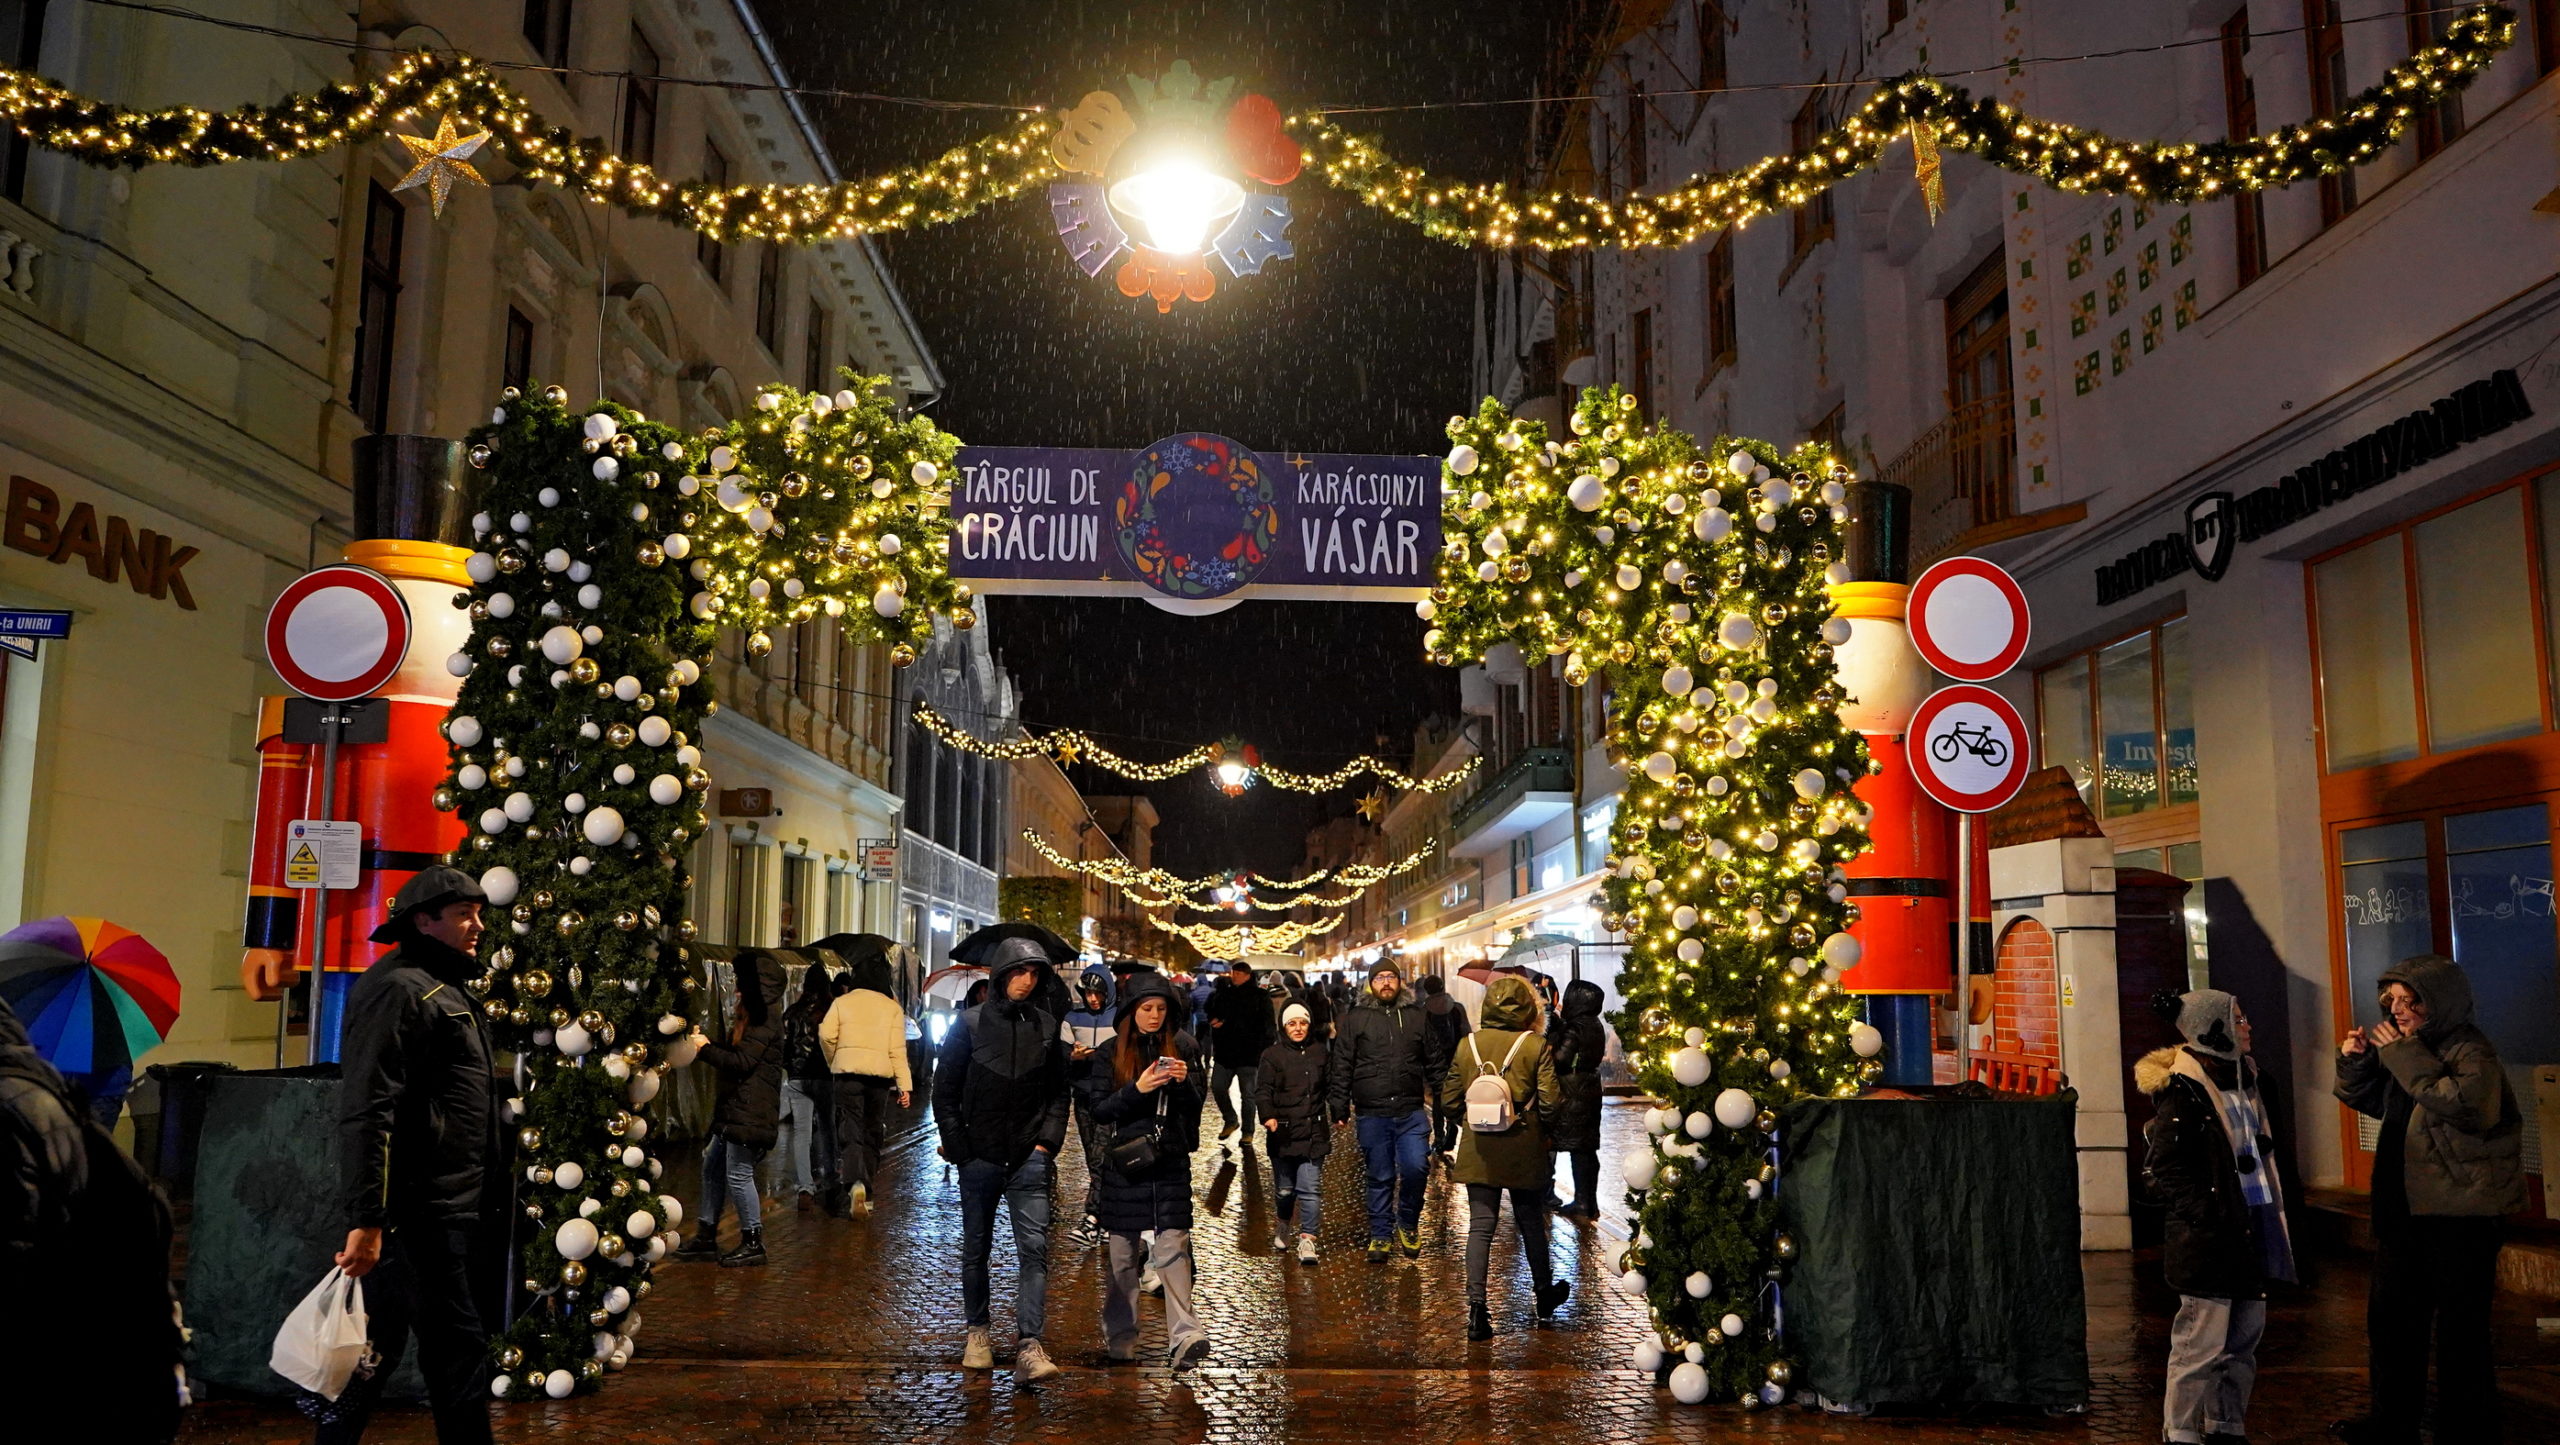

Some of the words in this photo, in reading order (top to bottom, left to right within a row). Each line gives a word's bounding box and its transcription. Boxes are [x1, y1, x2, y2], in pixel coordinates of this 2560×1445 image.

[962, 459, 1057, 505] TÂRGUL
[1069, 468, 1101, 506] DE
[1298, 466, 1424, 507] KARÁCSONYI
[3, 475, 201, 611] BANK
[962, 505, 1099, 562] CRĂCIUN
[1301, 505, 1420, 575] VÁSÁR
[2194, 511, 2218, 545] BT
[17, 617, 52, 631] UNIRII
